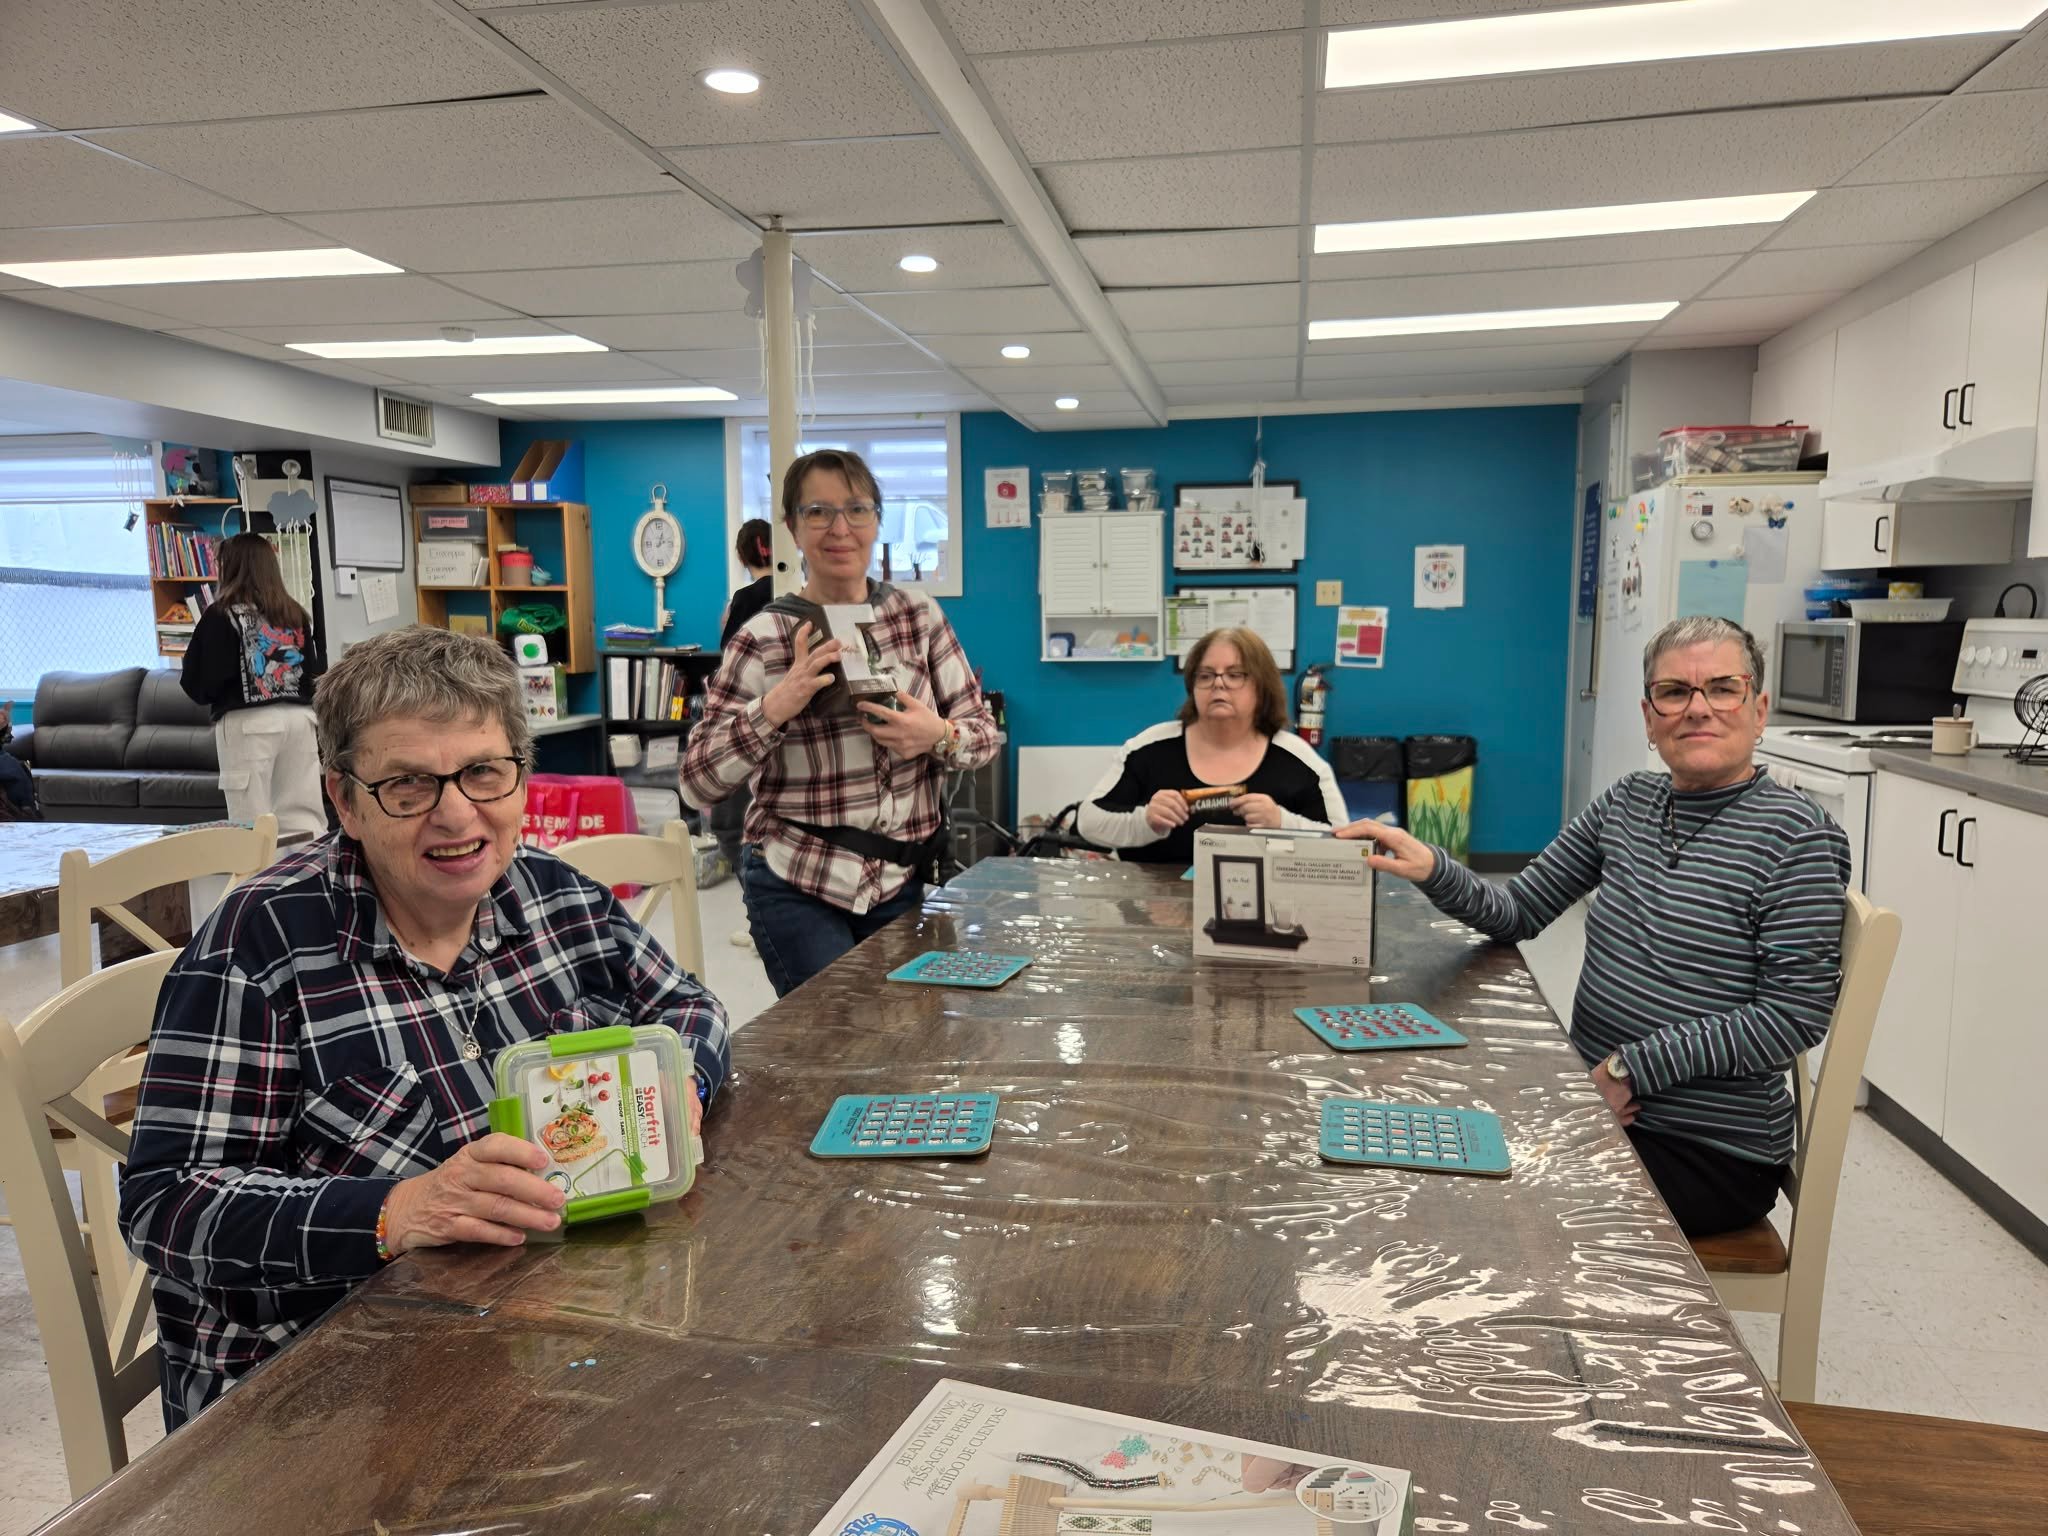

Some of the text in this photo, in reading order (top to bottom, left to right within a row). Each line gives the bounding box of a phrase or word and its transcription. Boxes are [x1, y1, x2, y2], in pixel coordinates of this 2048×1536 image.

[580, 814, 605, 830] DE
[643, 1085, 661, 1147] Starfrit
[896, 1439, 926, 1467] BEAD
[918, 1399, 960, 1439] WEAVING
[909, 1402, 985, 1487] TISSAGE DE PERLES
[932, 1407, 1007, 1496] TEJIDO DE CUENTAS
